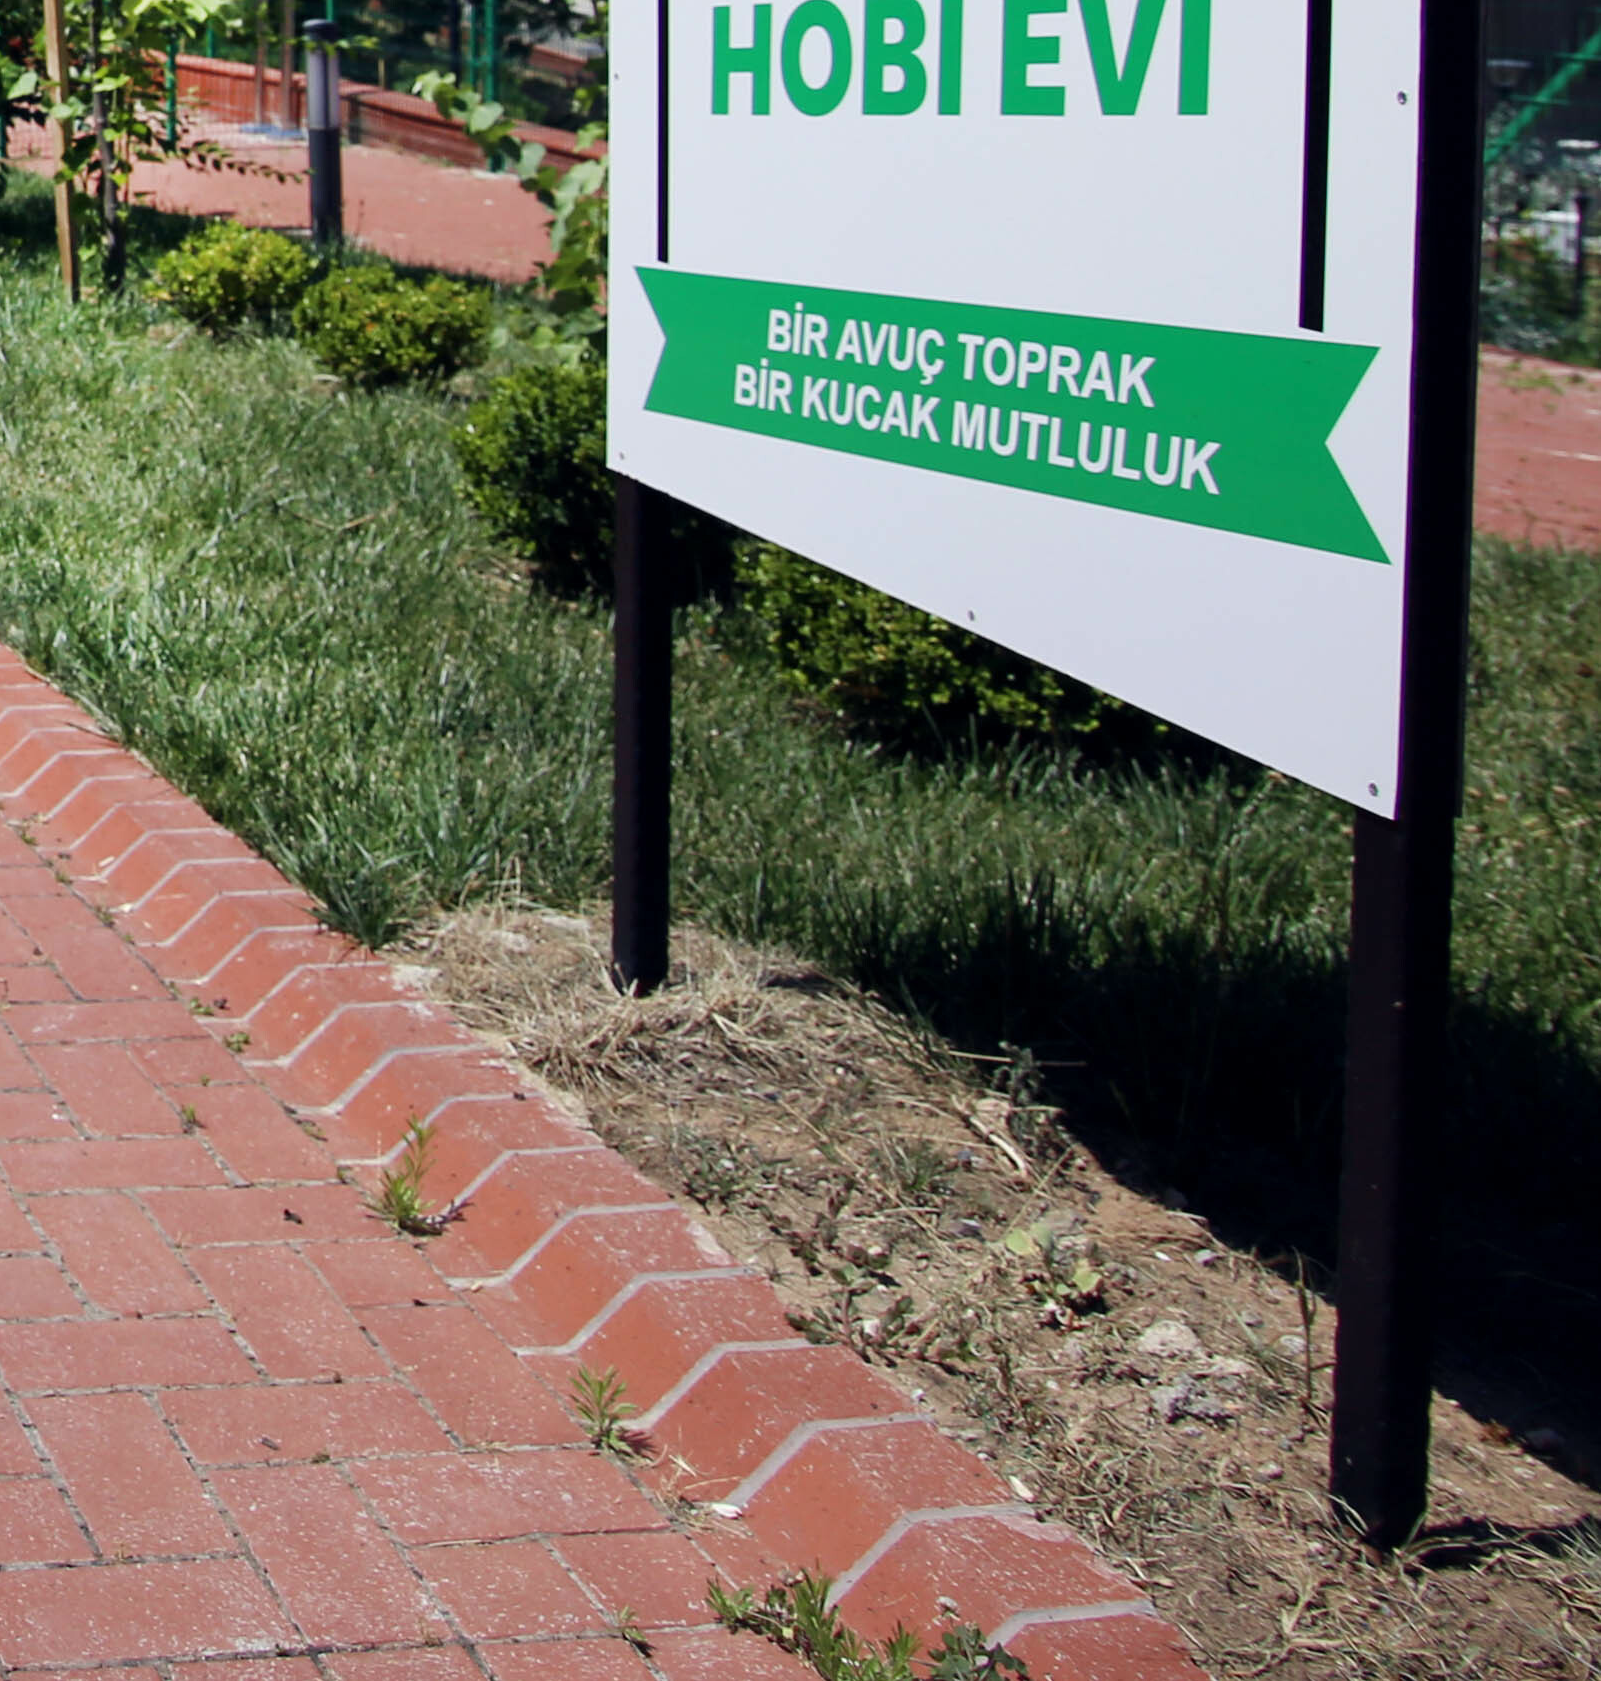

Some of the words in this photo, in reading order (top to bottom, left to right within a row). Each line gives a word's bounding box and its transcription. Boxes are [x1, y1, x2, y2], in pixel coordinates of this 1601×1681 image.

[767, 302, 830, 360] BİR
[834, 319, 947, 386] AVUÇ
[957, 333, 1157, 408] TOPRAK
[733, 357, 794, 415] BİR
[801, 375, 942, 444] KUCAK
[951, 399, 1223, 496] MUTLULUK
